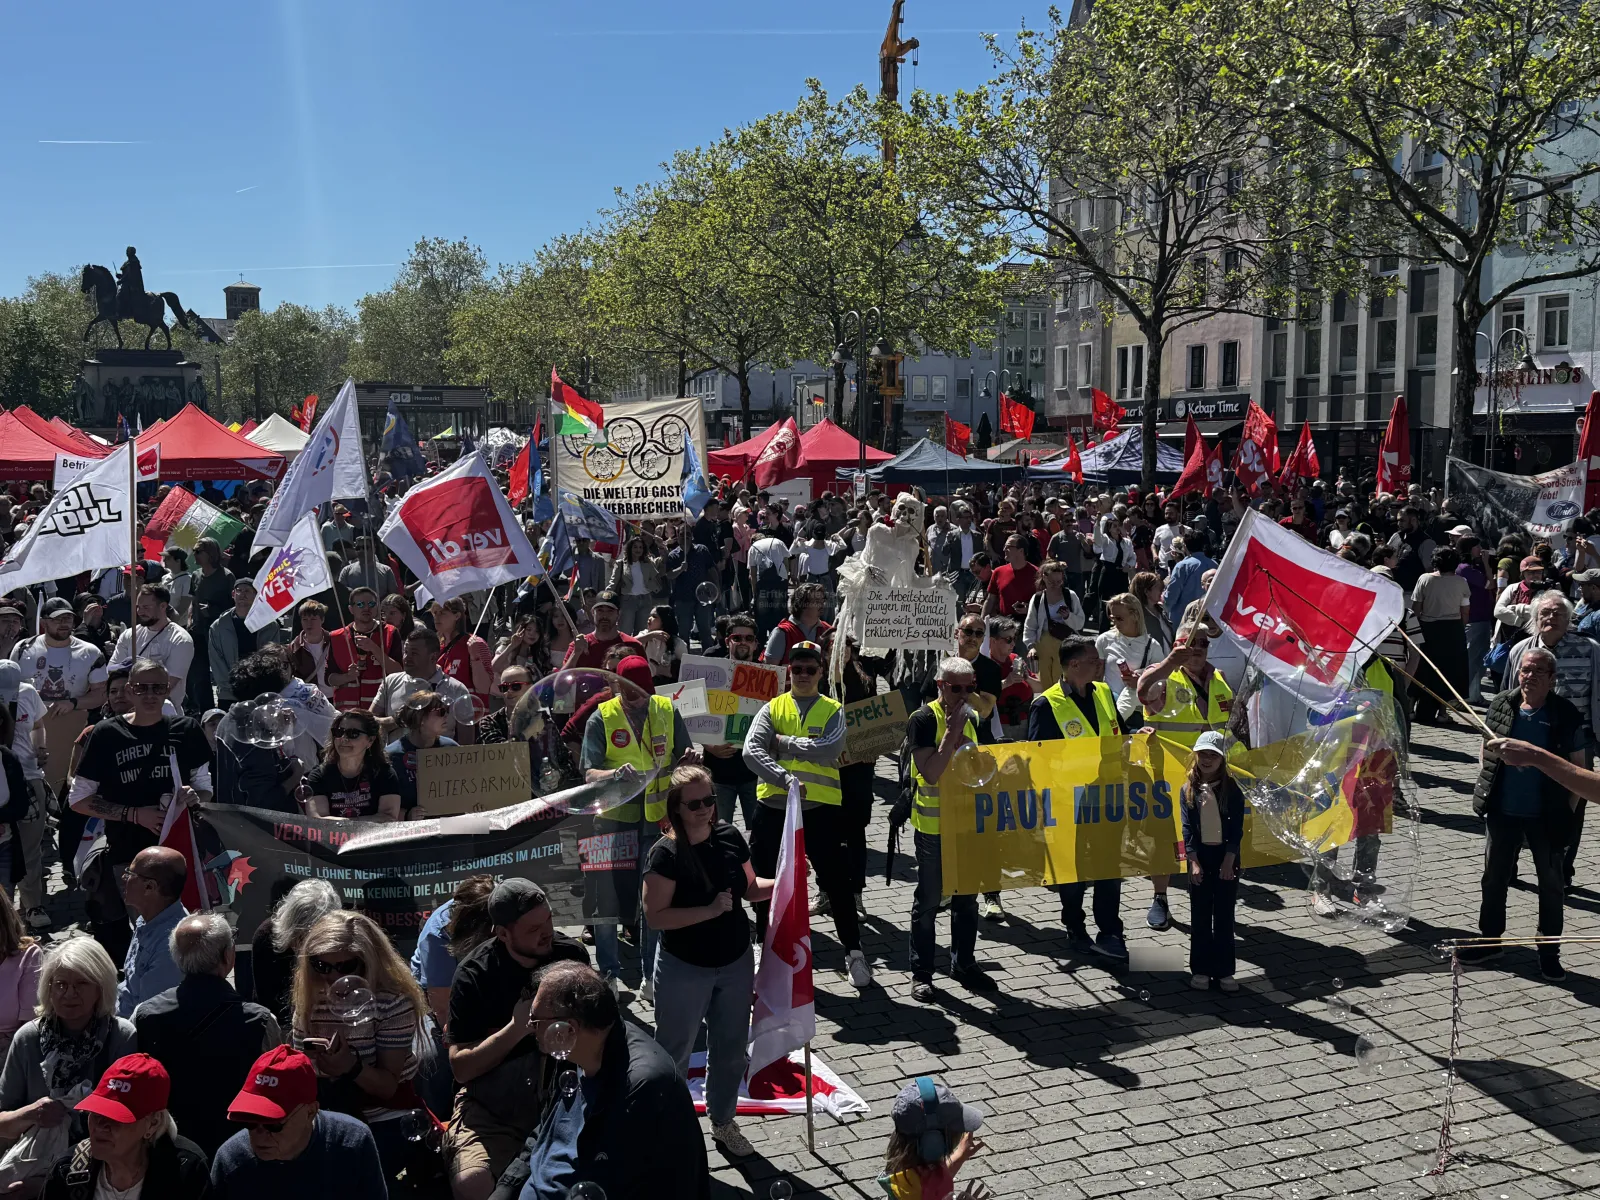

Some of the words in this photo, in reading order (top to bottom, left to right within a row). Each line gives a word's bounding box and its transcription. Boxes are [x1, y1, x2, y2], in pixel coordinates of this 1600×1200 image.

[1187, 402, 1216, 418] Kebap
[1216, 400, 1240, 413] Time
[62, 458, 89, 470] Betri
[583, 487, 601, 500] DIE
[602, 486, 632, 499] WELT
[634, 486, 649, 499] ZU
[651, 484, 681, 498] GAST
[604, 501, 684, 515] VERBRECHERN
[867, 590, 883, 601] Die
[865, 602, 899, 615] gungen
[900, 602, 911, 612] im
[912, 602, 948, 617] Handel
[865, 615, 892, 625] lassen
[892, 615, 911, 625] sich
[915, 615, 948, 628] rational
[731, 665, 778, 698] DRUCK
[845, 695, 893, 728] spekt
[425, 748, 506, 768] ENDSTATION
[974, 787, 1057, 834] PAUL
[1073, 780, 1173, 825] MUSS
[273, 822, 323, 843] VER.DI
[577, 830, 639, 854] ZUSAMMEN
[284, 863, 312, 877] EURE
[316, 864, 351, 880] LÖHNE
[354, 865, 401, 880] NEHMEN
[403, 861, 443, 877] WÜRDE
[452, 855, 514, 873] BESONDERS
[515, 850, 529, 863] IM
[530, 842, 563, 860] ALTER!
[588, 844, 640, 864] HANDELN
[343, 887, 365, 899] WIR
[366, 885, 411, 899] KENNEN
[413, 884, 431, 897] DIE
[106, 1078, 132, 1093] SPD
[254, 1073, 279, 1088] SPD
